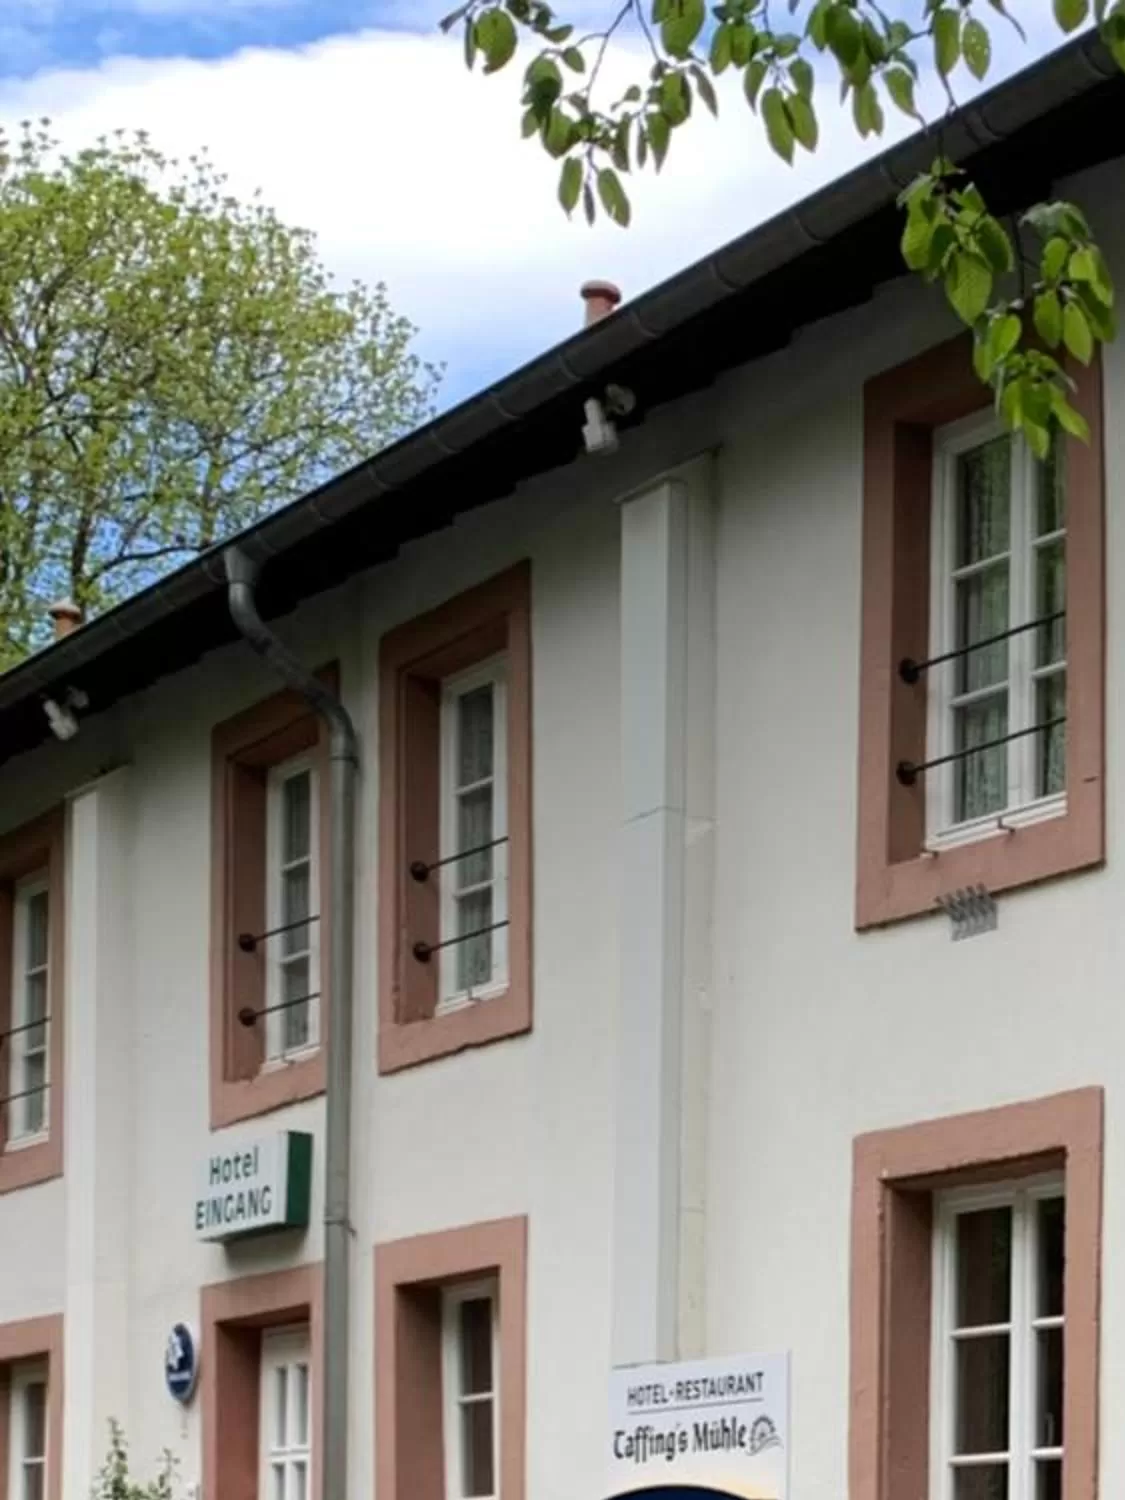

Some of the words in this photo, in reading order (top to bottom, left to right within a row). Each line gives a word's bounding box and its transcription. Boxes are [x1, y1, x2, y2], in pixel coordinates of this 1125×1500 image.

[209, 1146, 259, 1185] Hotel
[195, 1185, 272, 1231] EINGANG
[692, 1416, 748, 1452] Mühle
